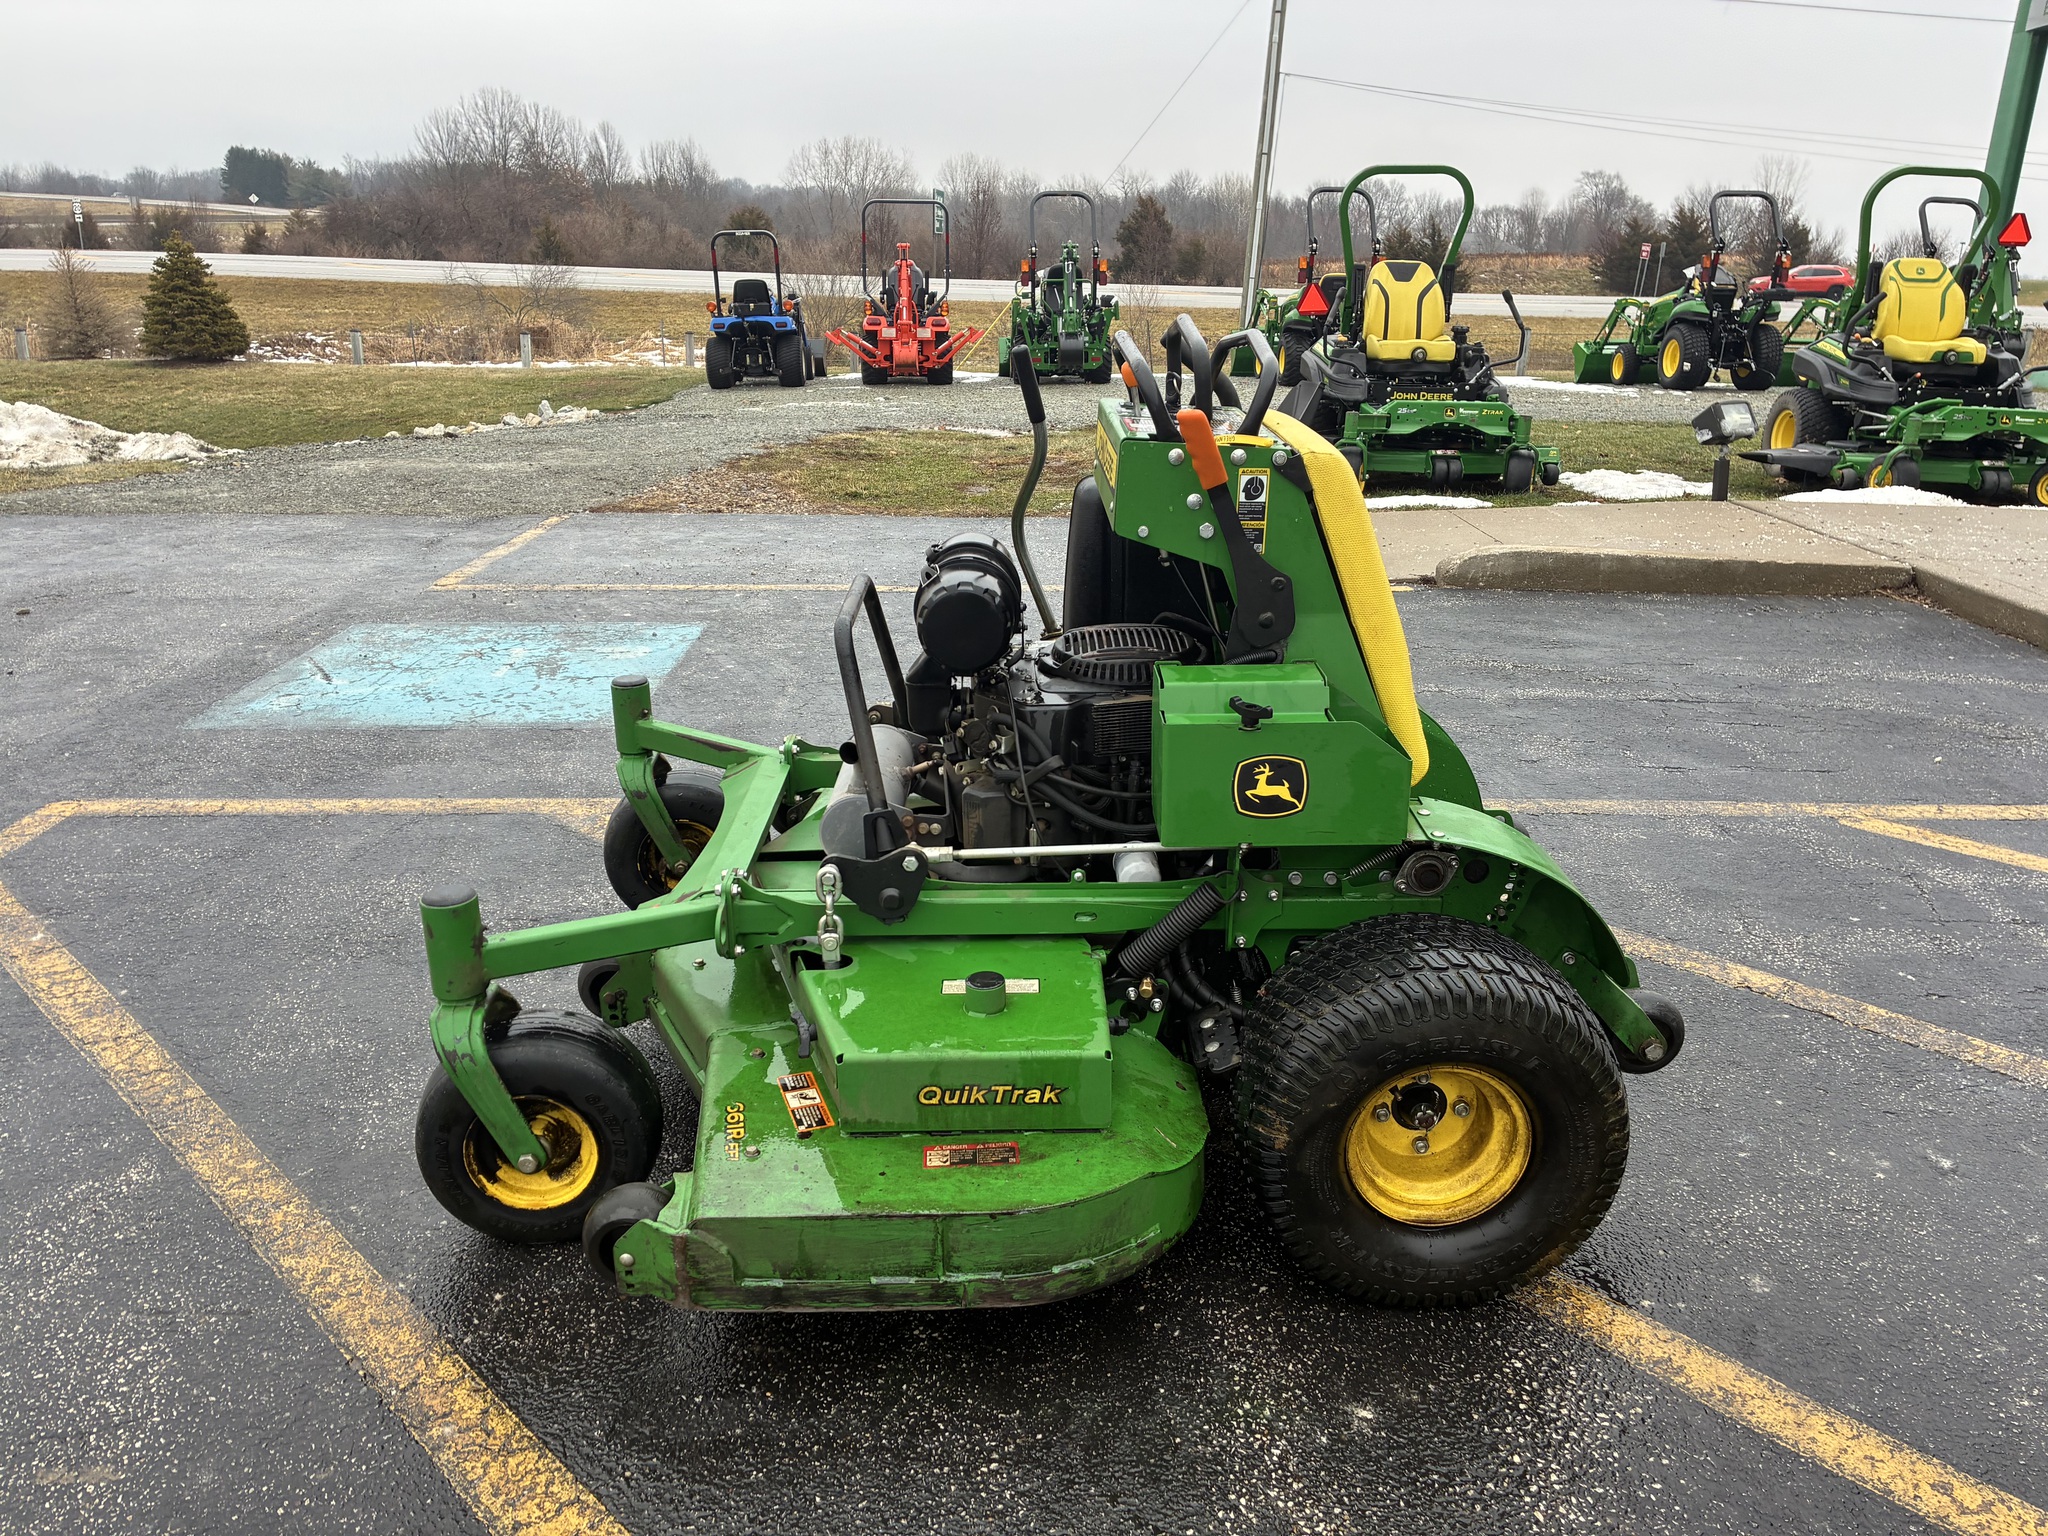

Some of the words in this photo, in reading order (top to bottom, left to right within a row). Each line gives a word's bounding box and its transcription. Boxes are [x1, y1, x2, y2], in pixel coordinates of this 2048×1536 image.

[1390, 391, 1418, 400] JOHN
[1420, 392, 1454, 400] DEERE
[1986, 411, 1998, 426] 5
[1376, 1036, 1553, 1072] CARLISLE
[917, 1084, 1067, 1106] QuikTrak
